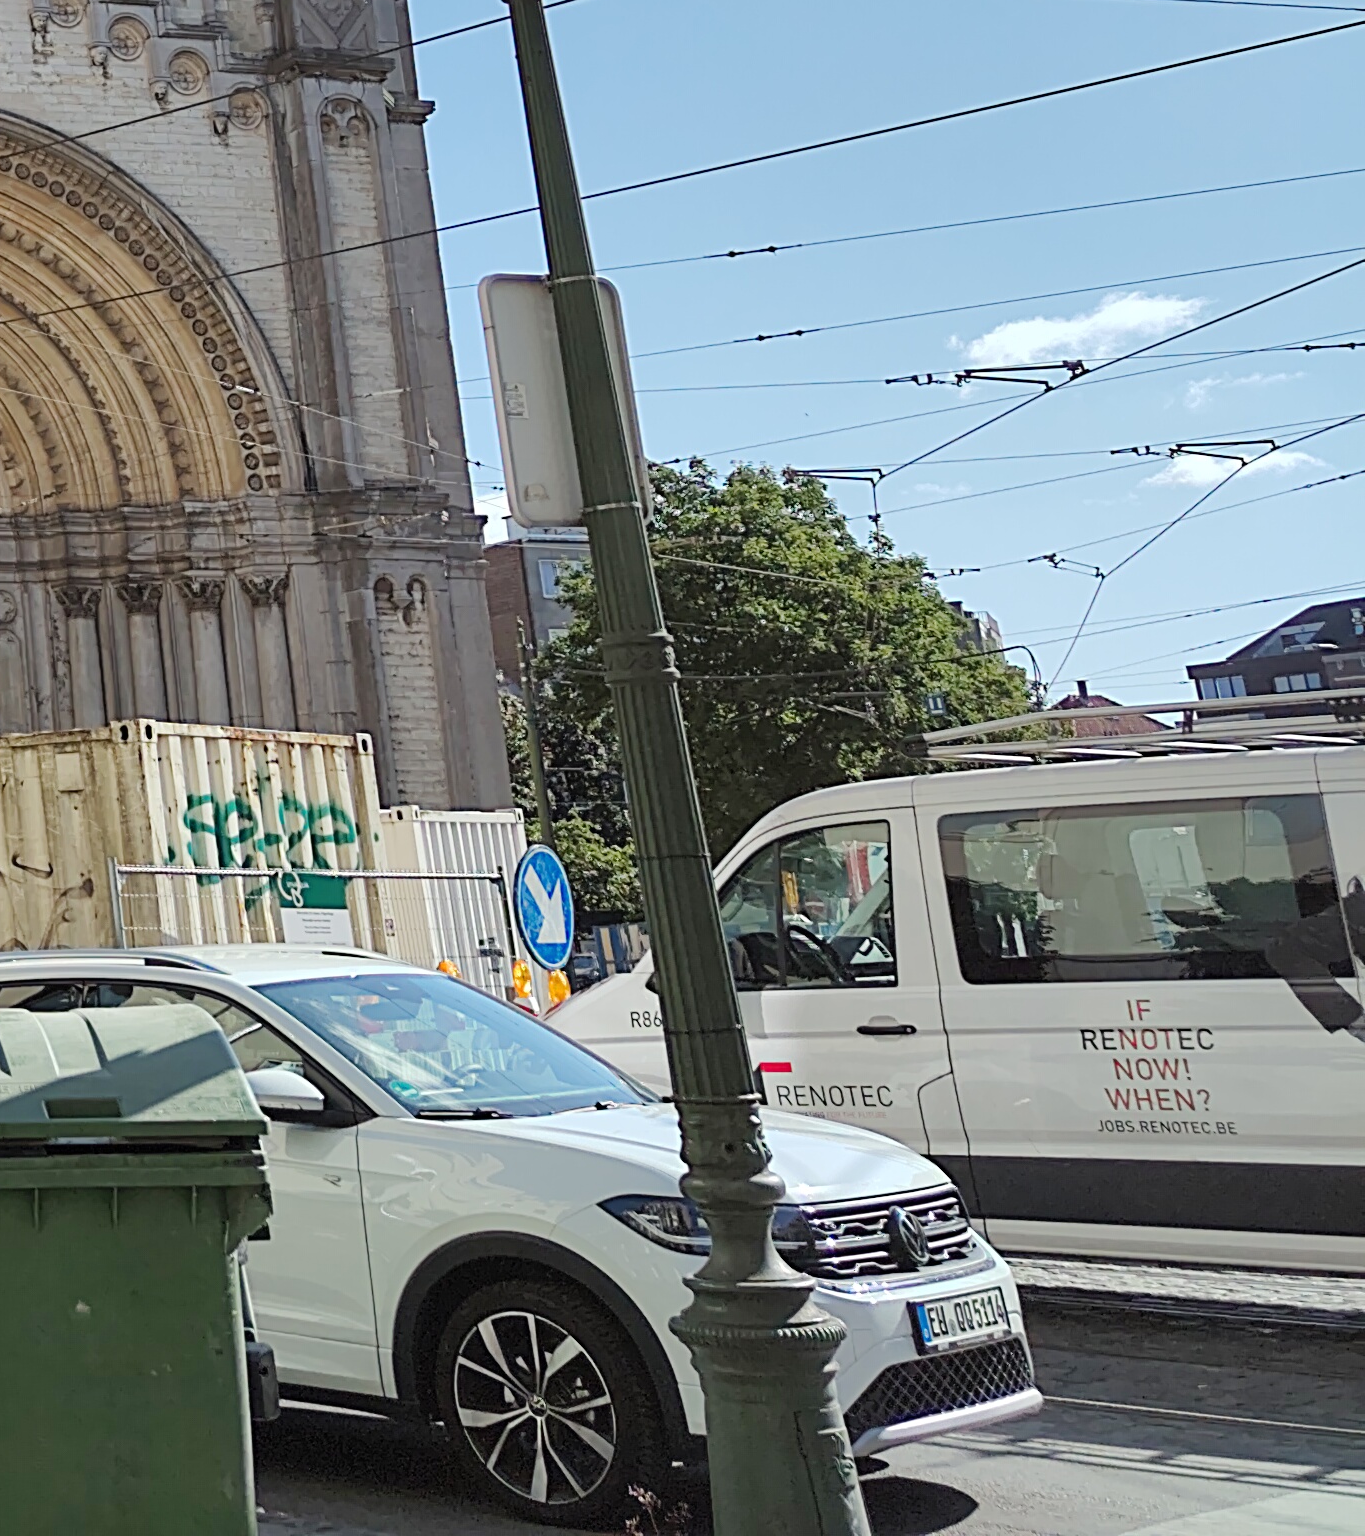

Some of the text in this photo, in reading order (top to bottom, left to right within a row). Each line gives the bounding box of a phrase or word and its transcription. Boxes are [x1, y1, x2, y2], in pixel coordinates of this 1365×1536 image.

[1126, 999, 1151, 1021] IF
[1080, 1028, 1214, 1050] RENOTEC
[1112, 1058, 1192, 1081] NOW!
[775, 1085, 894, 1107] RENOTEC
[1104, 1088, 1211, 1111] WHEN?
[1097, 1120, 1238, 1135] JOBS.RENOTEC.BE
